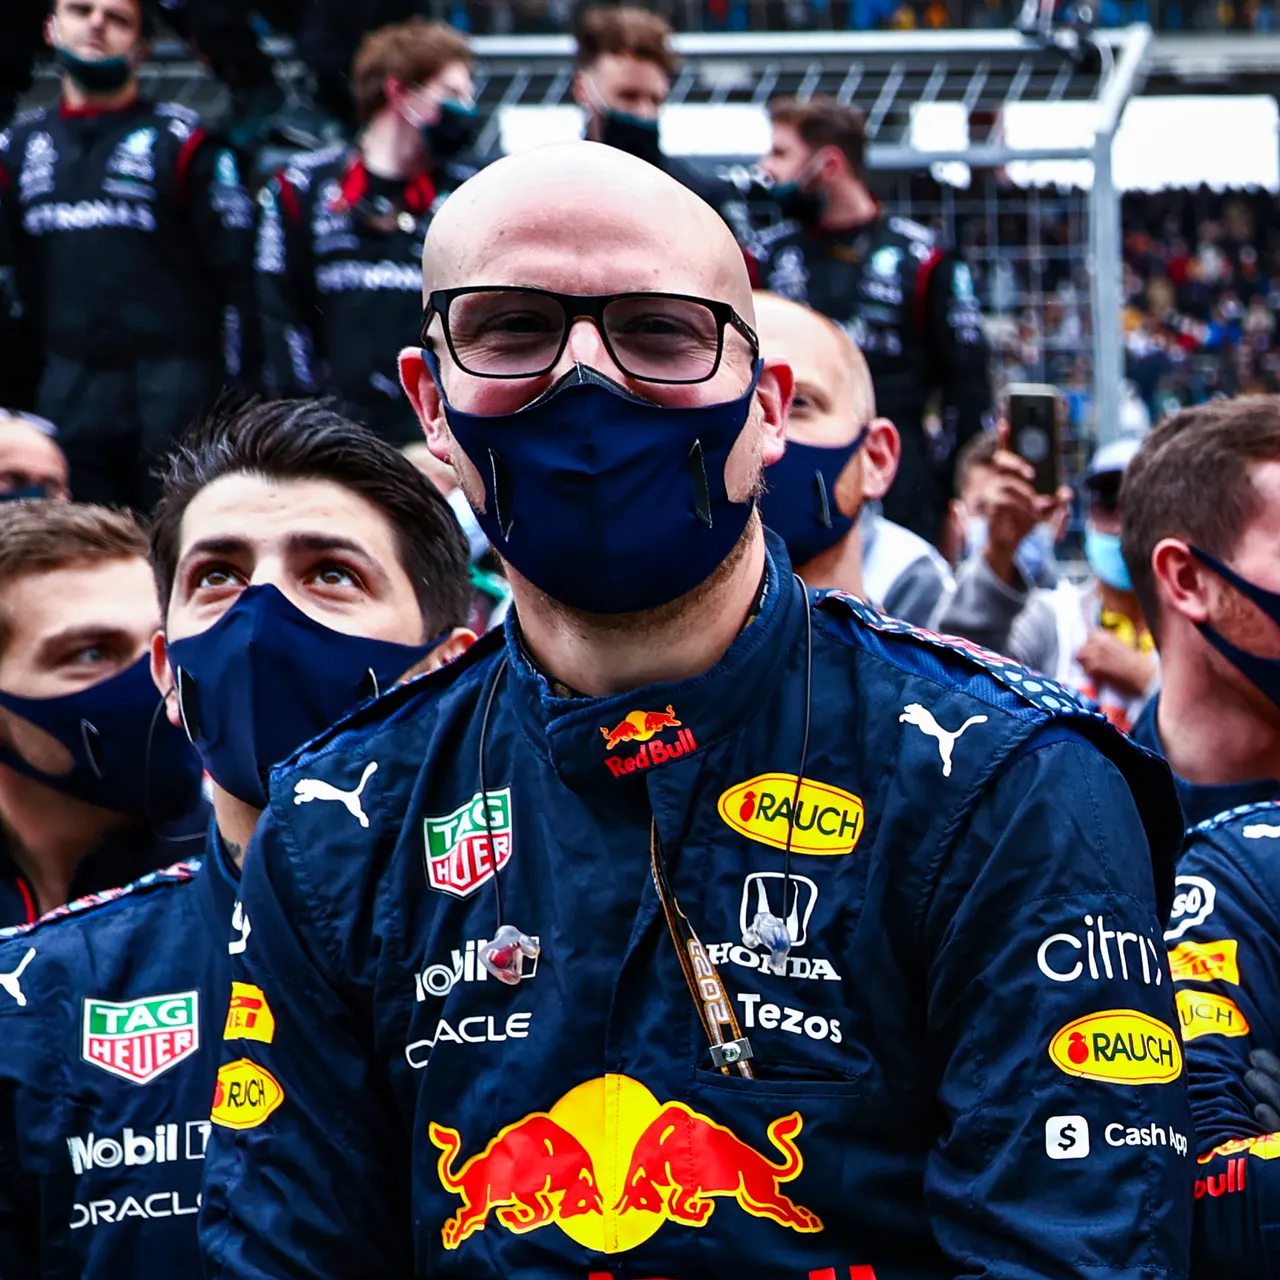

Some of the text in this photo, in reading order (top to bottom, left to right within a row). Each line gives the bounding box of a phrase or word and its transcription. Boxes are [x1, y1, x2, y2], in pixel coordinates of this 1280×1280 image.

[604, 728, 698, 780] Red Bull
[433, 798, 504, 850] TAG
[756, 792, 860, 840] RAUCH
[435, 836, 510, 886] HUER
[96, 1003, 189, 1035] TAG
[737, 993, 843, 1044] Tezos
[1181, 1002, 1232, 1027] UCH
[89, 1029, 194, 1079] HEUER
[406, 1012, 533, 1070] OACLE
[1092, 1032, 1174, 1069] RAUCH
[1104, 1122, 1166, 1148] Cash
[1169, 1125, 1188, 1157] App
[69, 1191, 203, 1230] ORACL
